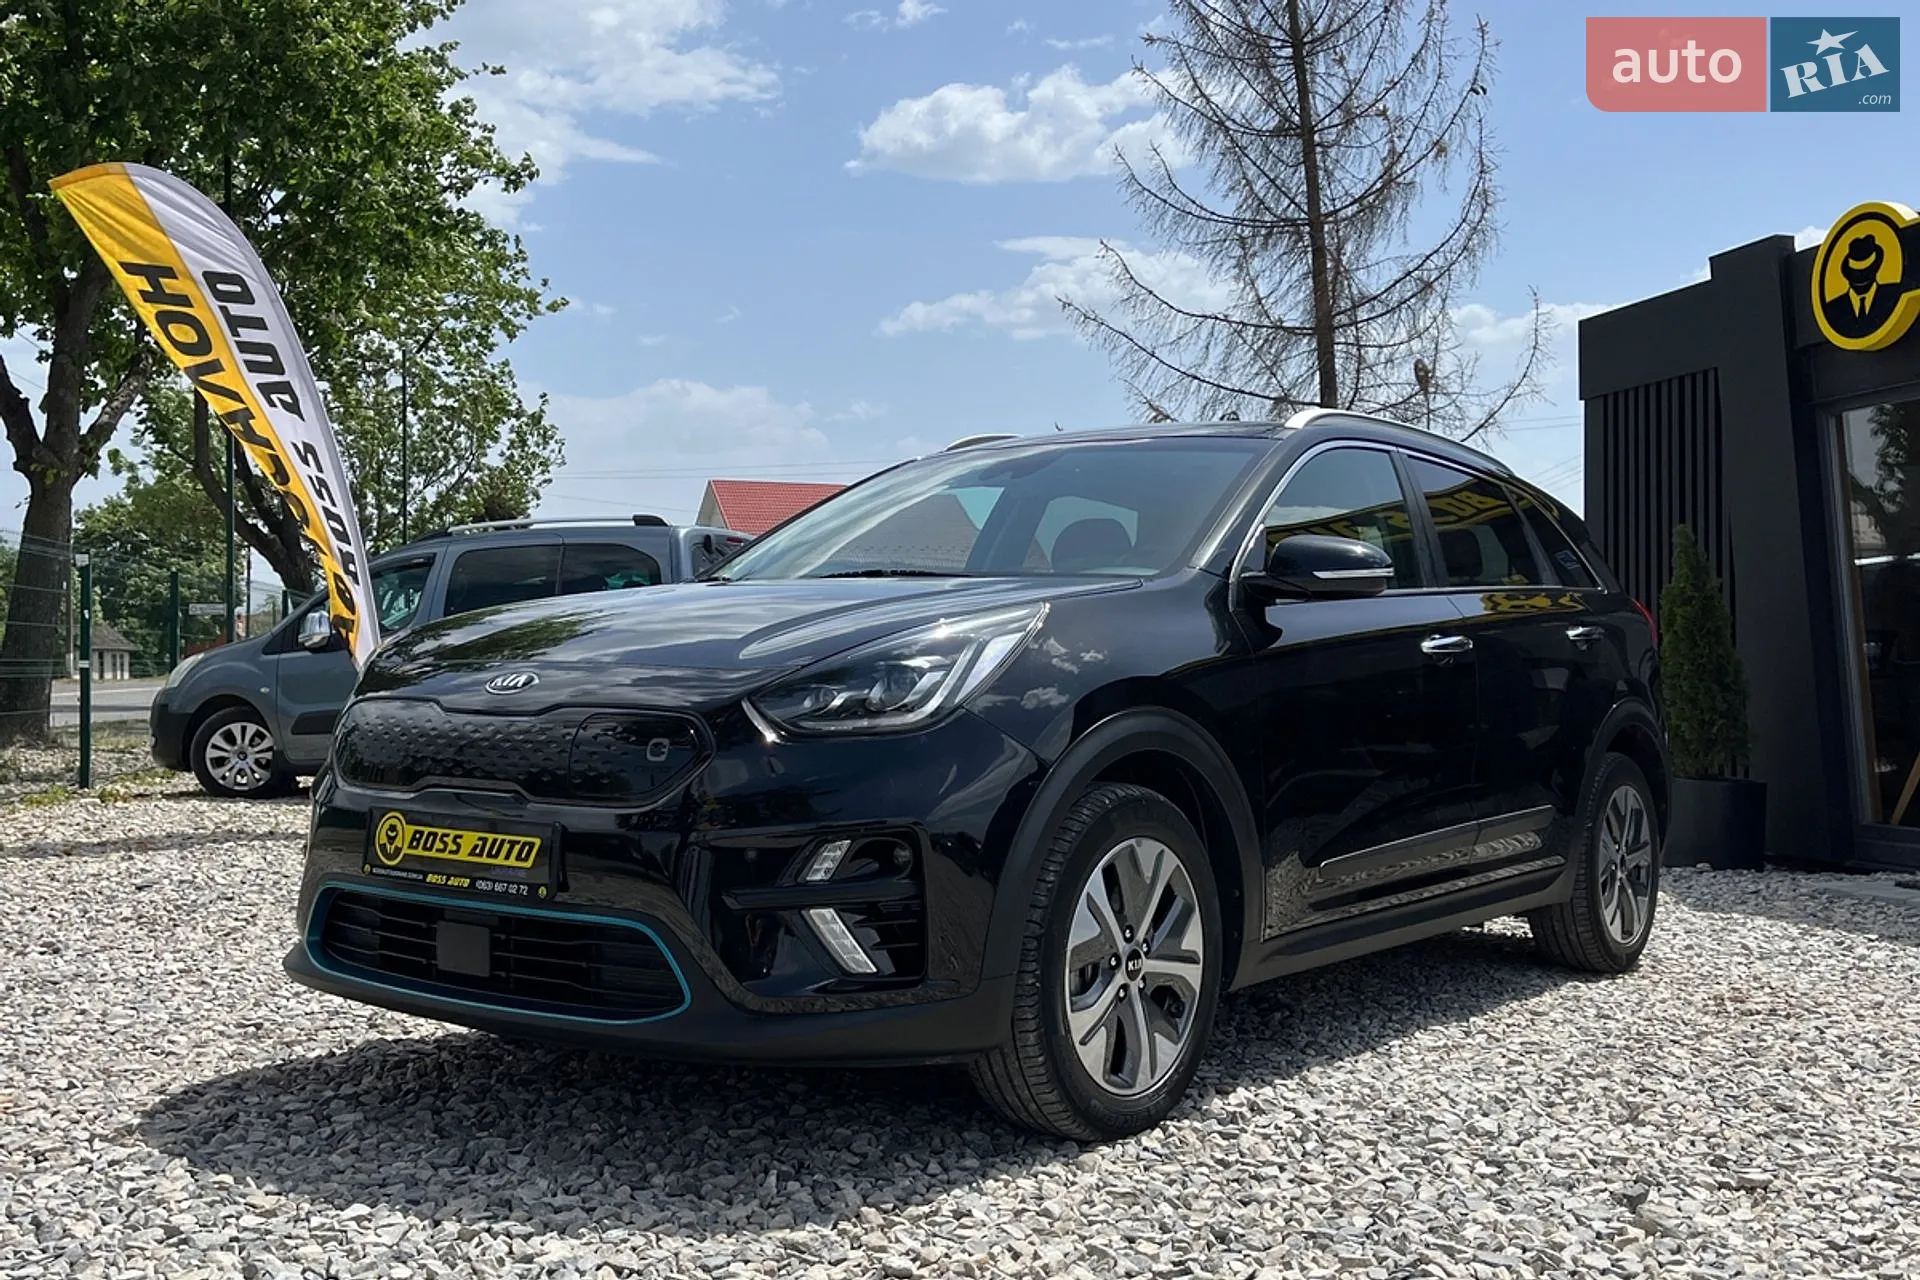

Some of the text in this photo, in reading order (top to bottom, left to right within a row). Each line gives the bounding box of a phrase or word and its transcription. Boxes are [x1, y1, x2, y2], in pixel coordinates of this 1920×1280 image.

[202, 269, 360, 587] BOSS AUTO
[407, 829, 536, 862] BOSS AUTO
[425, 873, 447, 884] BOSS
[447, 876, 471, 888] AUTO
[519, 884, 529, 896] 72
